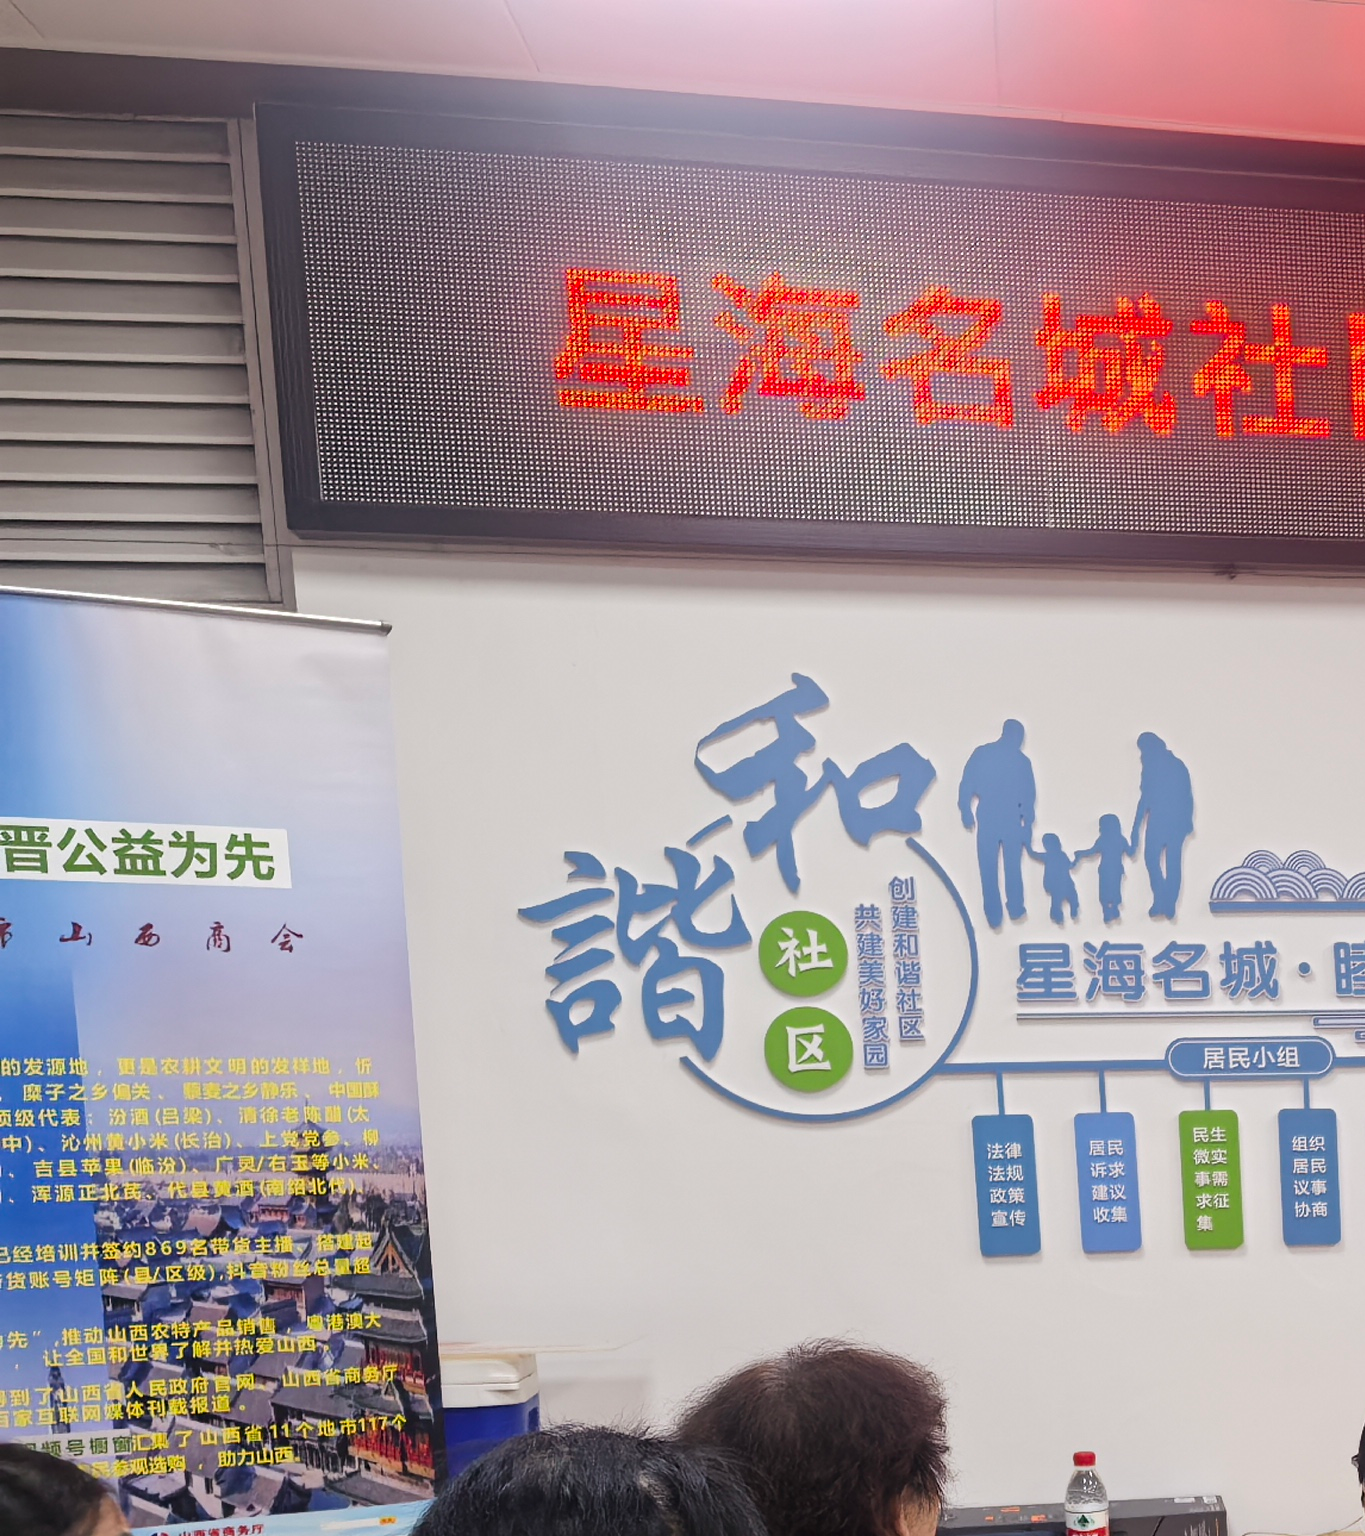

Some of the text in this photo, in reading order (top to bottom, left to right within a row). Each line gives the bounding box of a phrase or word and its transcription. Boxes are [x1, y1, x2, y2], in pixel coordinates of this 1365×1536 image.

[888, 875, 925, 1043] 创建和谐社区
[855, 904, 890, 1071] 共建美好家园
[1202, 1045, 1302, 1071] 居民小组
[1193, 1127, 1227, 1143] 民生
[987, 1143, 1022, 1160] 法律
[1089, 1140, 1124, 1157] 居民
[1292, 1136, 1325, 1152] 组织
[1193, 1149, 1227, 1165] 微实
[988, 1164, 1024, 1182] 法规
[1091, 1162, 1125, 1179] 诉求
[1293, 1158, 1326, 1174] 居民
[1194, 1171, 1229, 1187] 事需
[990, 1187, 1025, 1205] 政策
[1092, 1184, 1126, 1202] 建议
[1294, 1180, 1327, 1196] 议事
[1196, 1193, 1229, 1209] 求征
[1094, 1207, 1128, 1223] 收集
[1295, 1202, 1328, 1218] 协商
[991, 1210, 1026, 1228] 宣传
[1197, 1215, 1213, 1231] 集
